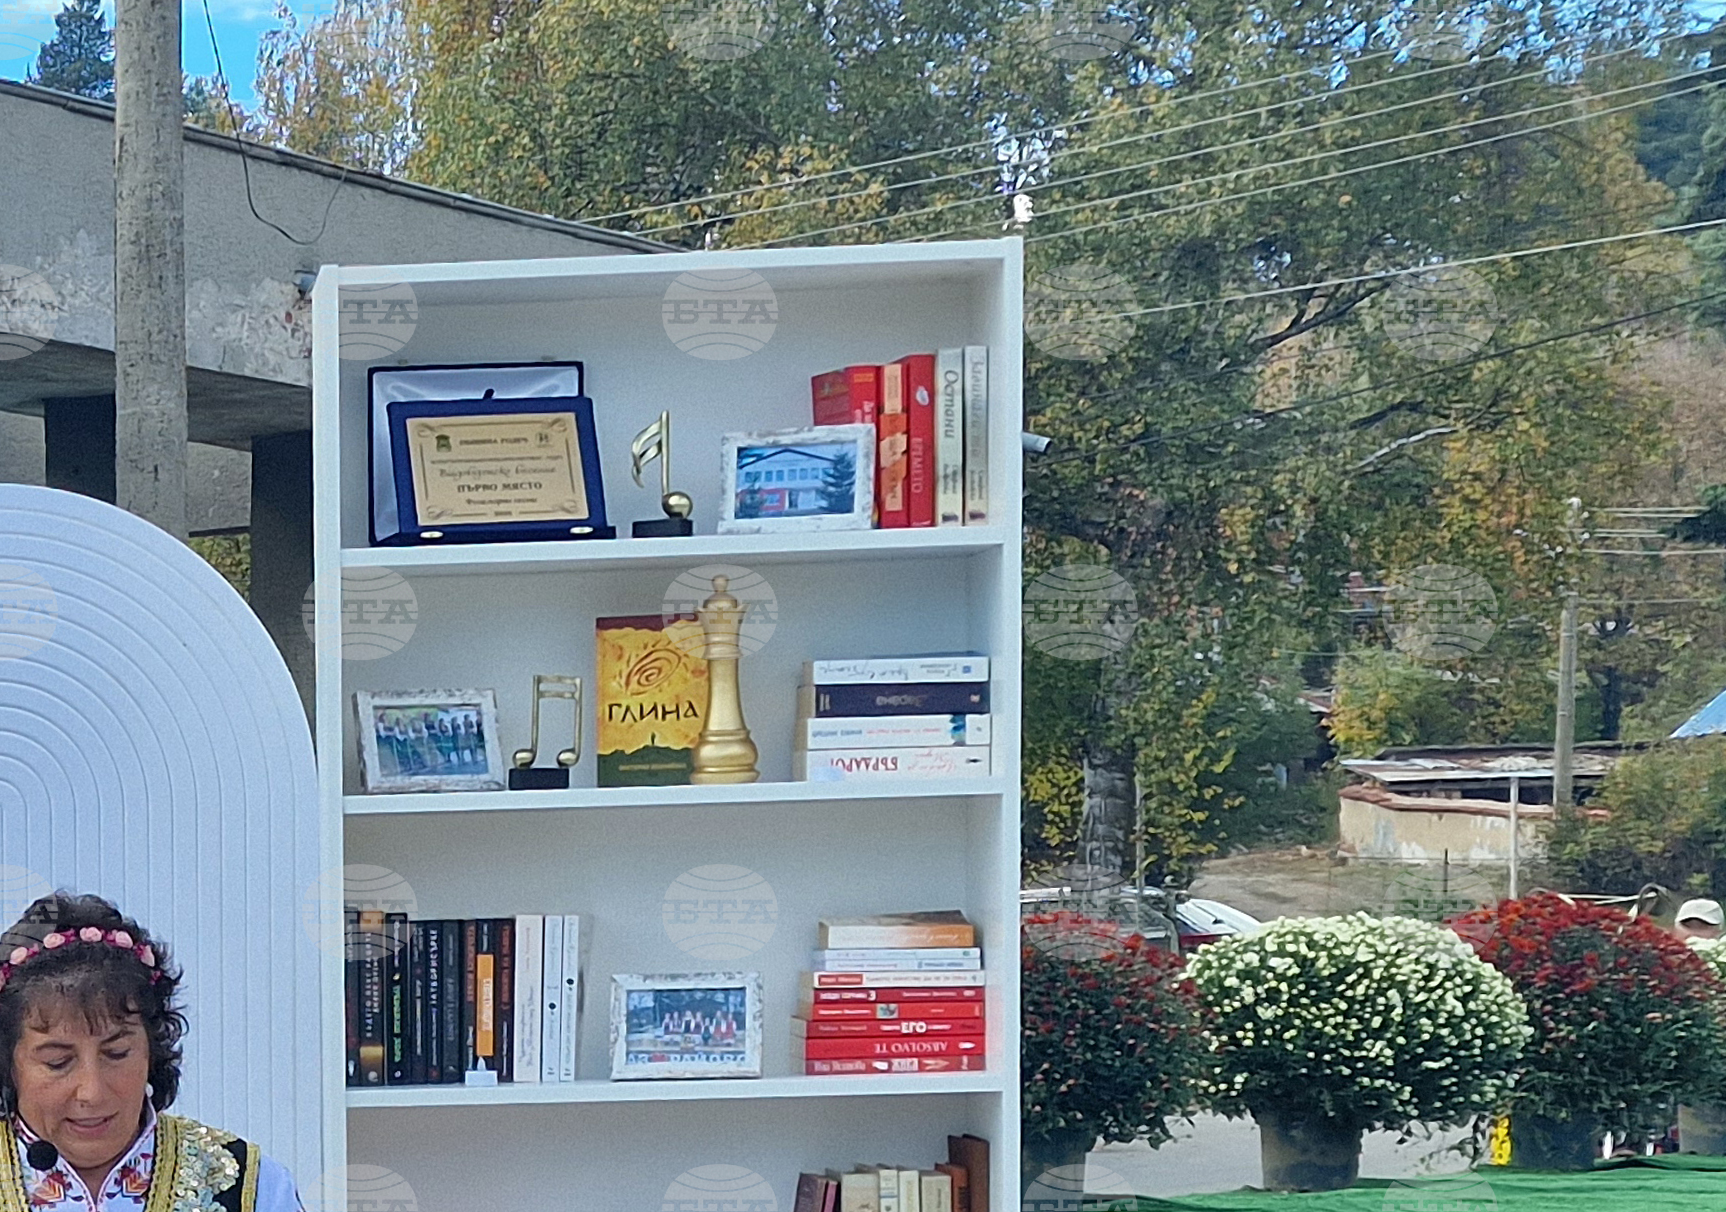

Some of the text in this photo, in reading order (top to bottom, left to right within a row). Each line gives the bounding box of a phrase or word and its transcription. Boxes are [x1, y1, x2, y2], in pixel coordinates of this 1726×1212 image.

[944, 369, 959, 439] Остани
[501, 481, 543, 491] МЯСТО
[607, 700, 700, 723] ГЛИНА
[900, 1021, 927, 1034] ЕГО
[874, 1041, 948, 1054] ABSOLVO TE
